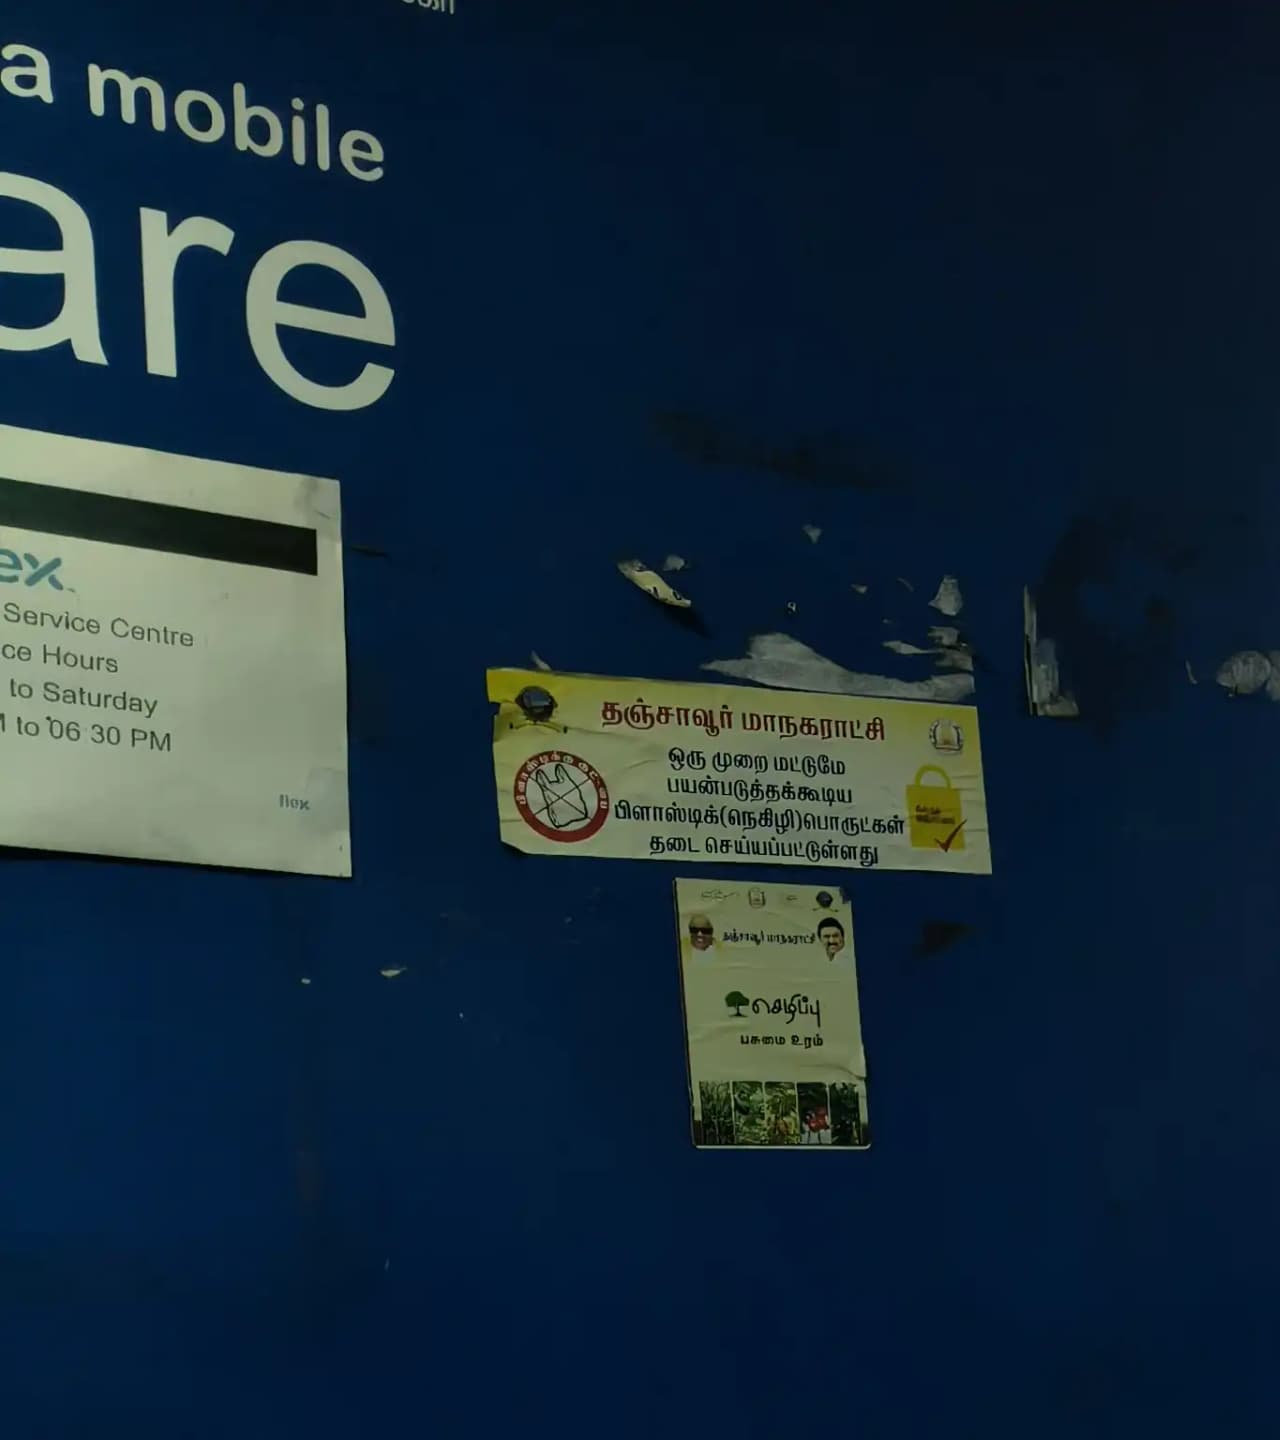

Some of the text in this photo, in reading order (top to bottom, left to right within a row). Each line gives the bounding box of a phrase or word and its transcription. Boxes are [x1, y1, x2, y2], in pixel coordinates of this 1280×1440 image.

[88, 82, 385, 182] mobile
[0, 171, 396, 411] are
[4, 602, 194, 647] Service Centre
[43, 644, 118, 673] Hours
[10, 678, 158, 718] to Saturday
[17, 716, 40, 736] to
[91, 724, 121, 746] 30
[131, 728, 172, 752] PM
[601, 698, 886, 741] தஞ்சாவூர் மாநகராட்சி
[668, 747, 847, 778] ஒரு முறை மட்டுமே
[667, 776, 852, 804] பயன்படுத்தக்கூடிய
[650, 835, 879, 867] தடை செய்யப்பட்டுள்ளது
[751, 993, 821, 1028] செழிப்பு
[740, 1033, 824, 1049] பசுமை உரம்
